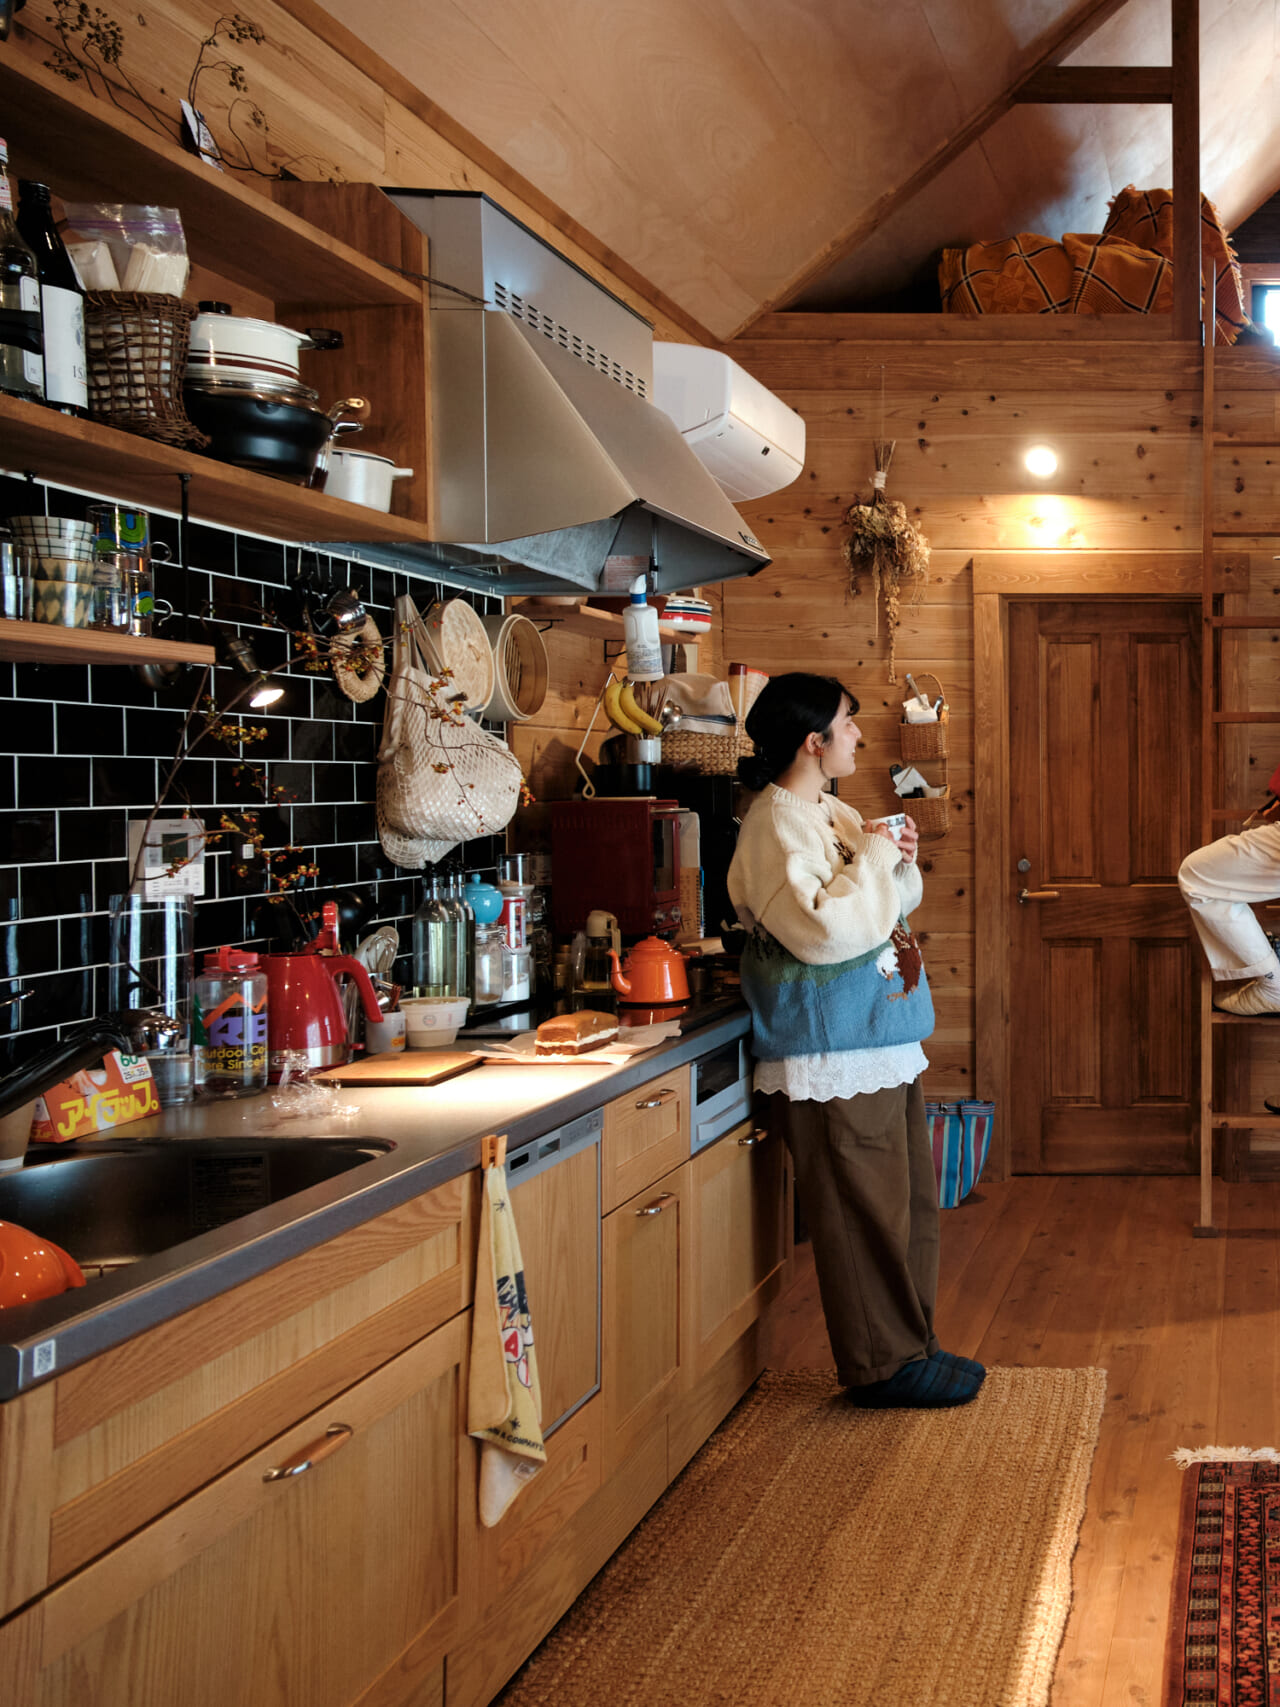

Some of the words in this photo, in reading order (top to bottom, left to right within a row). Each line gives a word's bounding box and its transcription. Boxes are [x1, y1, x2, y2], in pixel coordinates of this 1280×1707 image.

[57, 1080, 160, 1137] アイラップ
